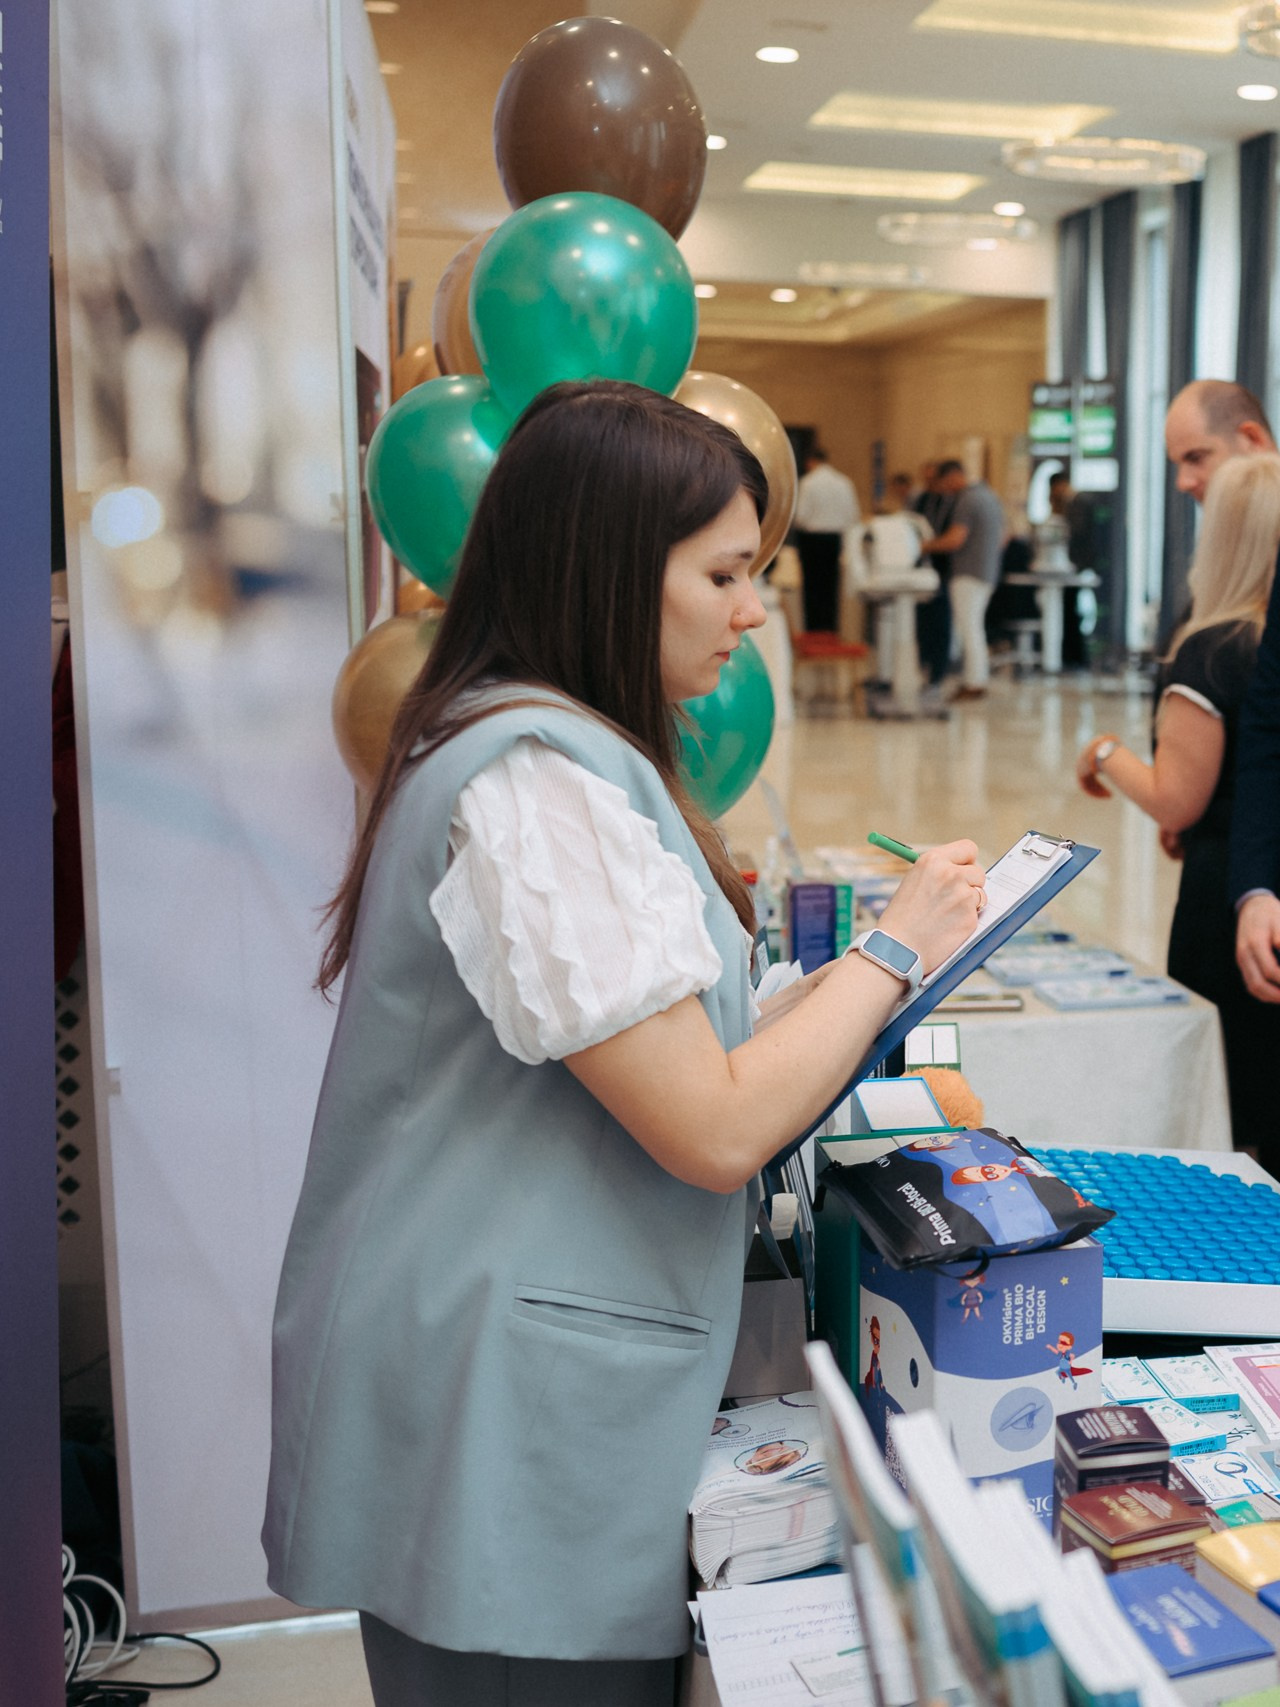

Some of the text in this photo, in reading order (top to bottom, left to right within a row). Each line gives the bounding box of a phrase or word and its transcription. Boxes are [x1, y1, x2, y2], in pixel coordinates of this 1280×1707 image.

[897, 1181, 927, 1208] Bi-focal
[928, 1211, 956, 1247] Prima
[1014, 1283, 1024, 1345] PRIMA BIO
[1025, 1285, 1035, 1340] BI-FOCAL
[1036, 1289, 1046, 1333] DESIGN
